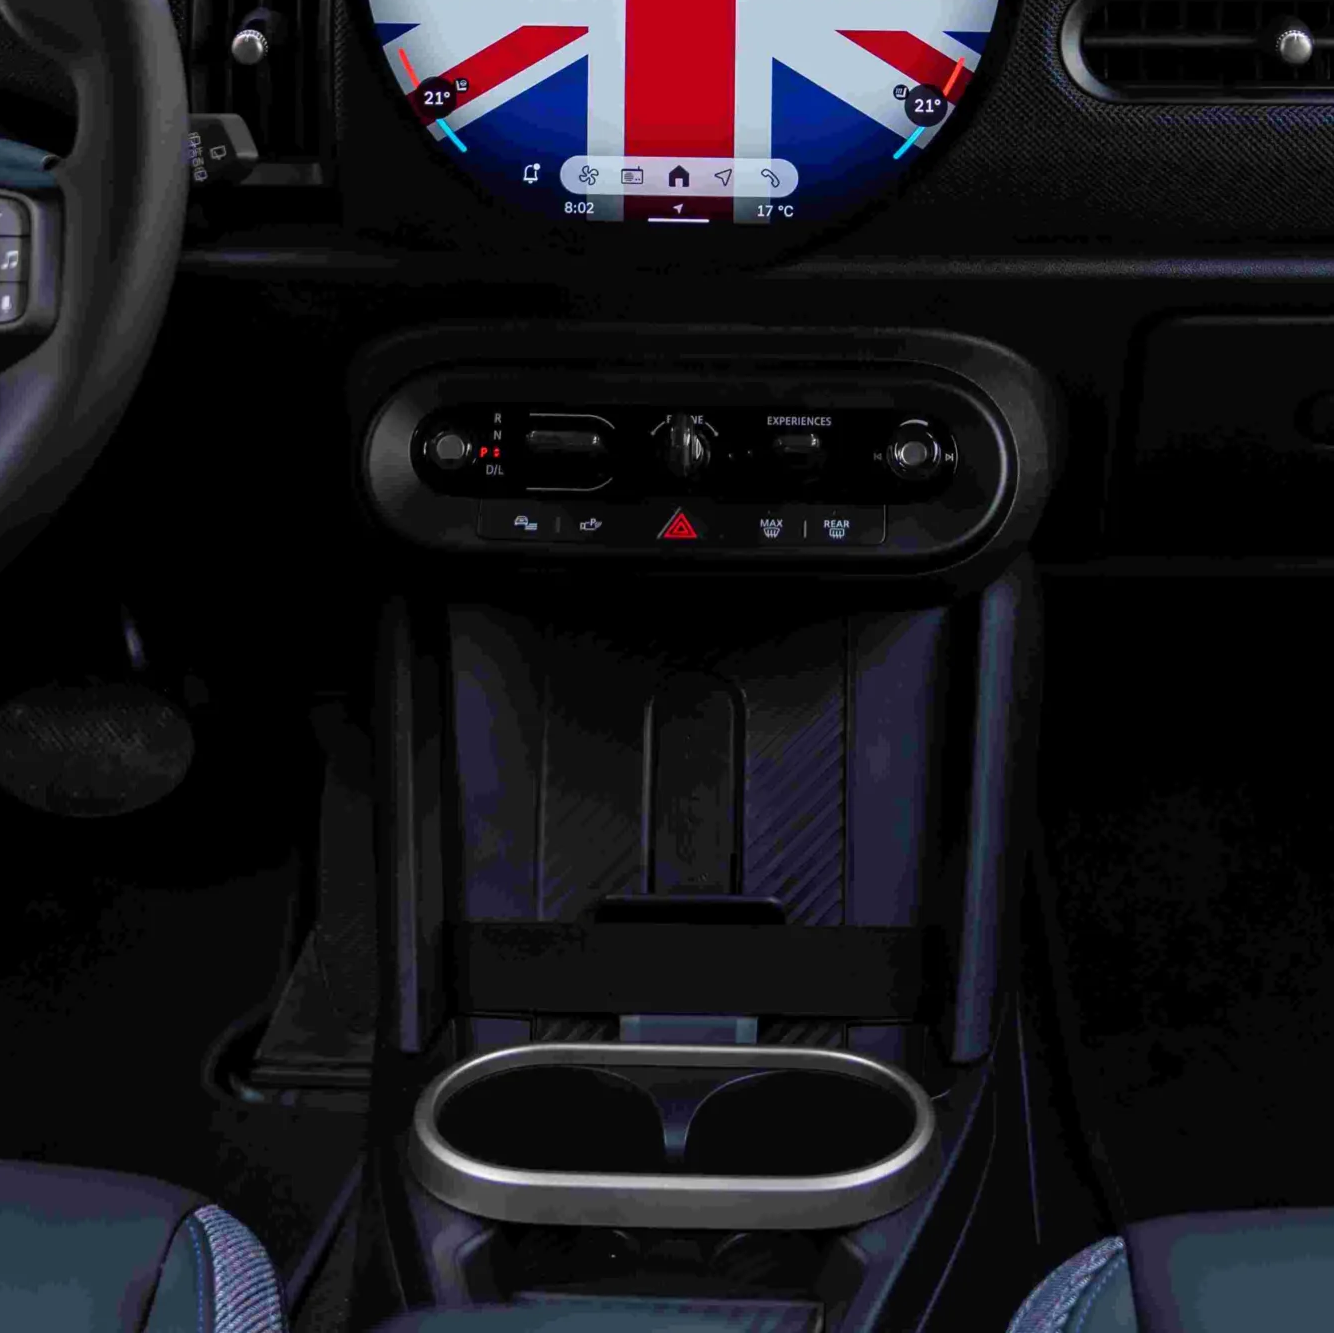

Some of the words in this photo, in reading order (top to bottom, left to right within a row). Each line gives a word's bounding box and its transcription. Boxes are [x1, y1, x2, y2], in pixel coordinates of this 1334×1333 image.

[424, 91, 451, 106] 21°
[914, 98, 941, 113] 21°
[564, 201, 594, 214] 8:02
[757, 205, 773, 217] 17
[493, 412, 502, 424] R
[767, 416, 832, 426] EXPERIENCES
[493, 429, 502, 440] N
[479, 446, 488, 458] P
[486, 464, 504, 475] D/L
[760, 519, 783, 528] MAX
[824, 519, 850, 529] REAR
